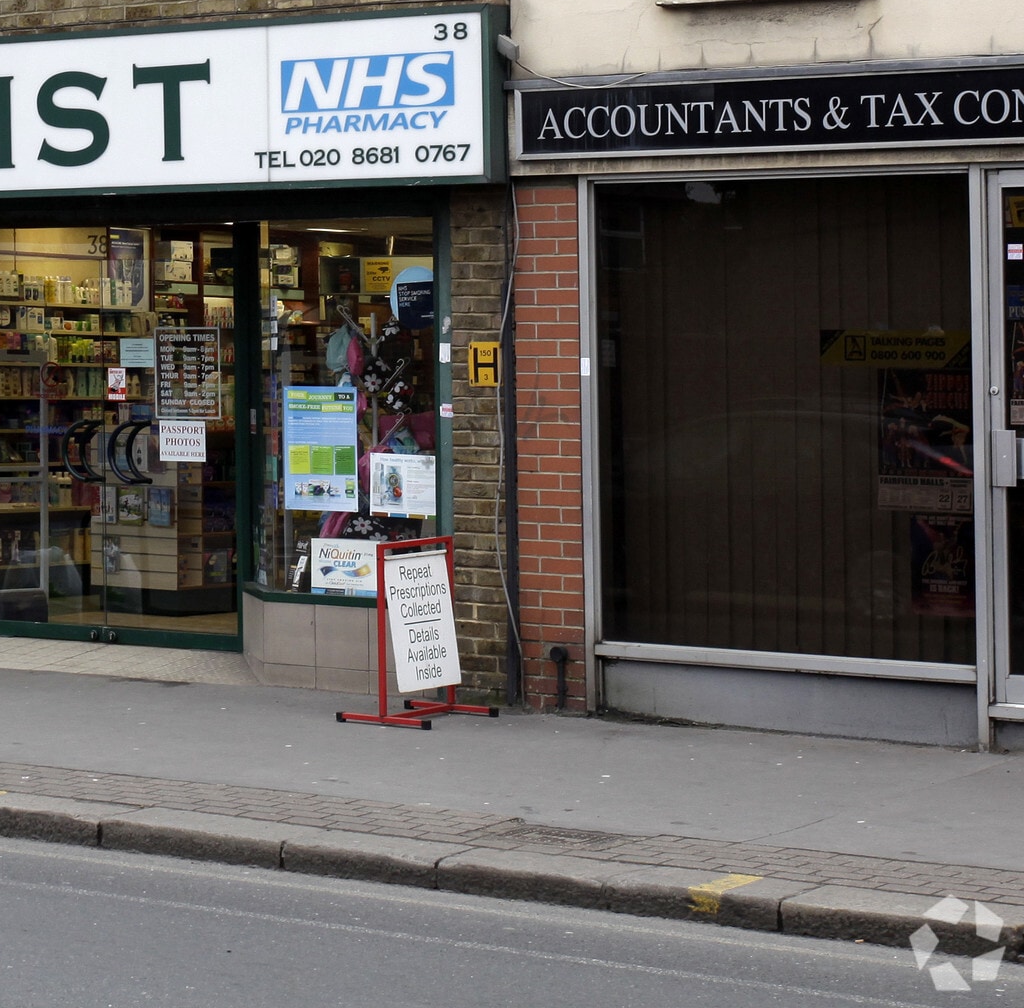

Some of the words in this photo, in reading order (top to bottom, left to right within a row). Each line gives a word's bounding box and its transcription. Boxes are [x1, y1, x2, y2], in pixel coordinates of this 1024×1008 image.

[434, 22, 468, 41] 38
[282, 52, 453, 111] NHS
[284, 110, 448, 135] PHARMACY
[537, 97, 812, 140] ACCOUNTANTS
[822, 96, 852, 130] &
[860, 91, 944, 128] TAX
[254, 150, 296, 169] TEL
[299, 148, 341, 166] 020
[351, 146, 400, 165] 8681
[414, 144, 471, 163] 0767
[88, 235, 108, 255] 38
[159, 334, 191, 342] OPENING
[192, 334, 215, 342] TIMES
[870, 337, 912, 346] TALKING
[915, 337, 946, 347] PAGES
[479, 349, 492, 357] 150
[870, 351, 898, 360] 0800
[901, 351, 921, 360] 600
[924, 351, 946, 360] 900
[483, 373, 489, 381] 3
[161, 425, 205, 435] PASSPORT
[165, 438, 201, 447] PHOTOS
[879, 477, 919, 485] FAIRFIELD
[919, 478, 945, 486] HALLS
[939, 494, 950, 503] 22
[956, 495, 968, 504] 27
[318, 548, 362, 561] NiQuitin
[333, 560, 356, 568] CLEAR
[399, 563, 433, 583] Repeat
[389, 582, 447, 601] Prescriptions
[400, 599, 442, 619] Collected
[408, 626, 440, 644] Details
[407, 644, 447, 663] Available
[416, 664, 443, 681] Inside
